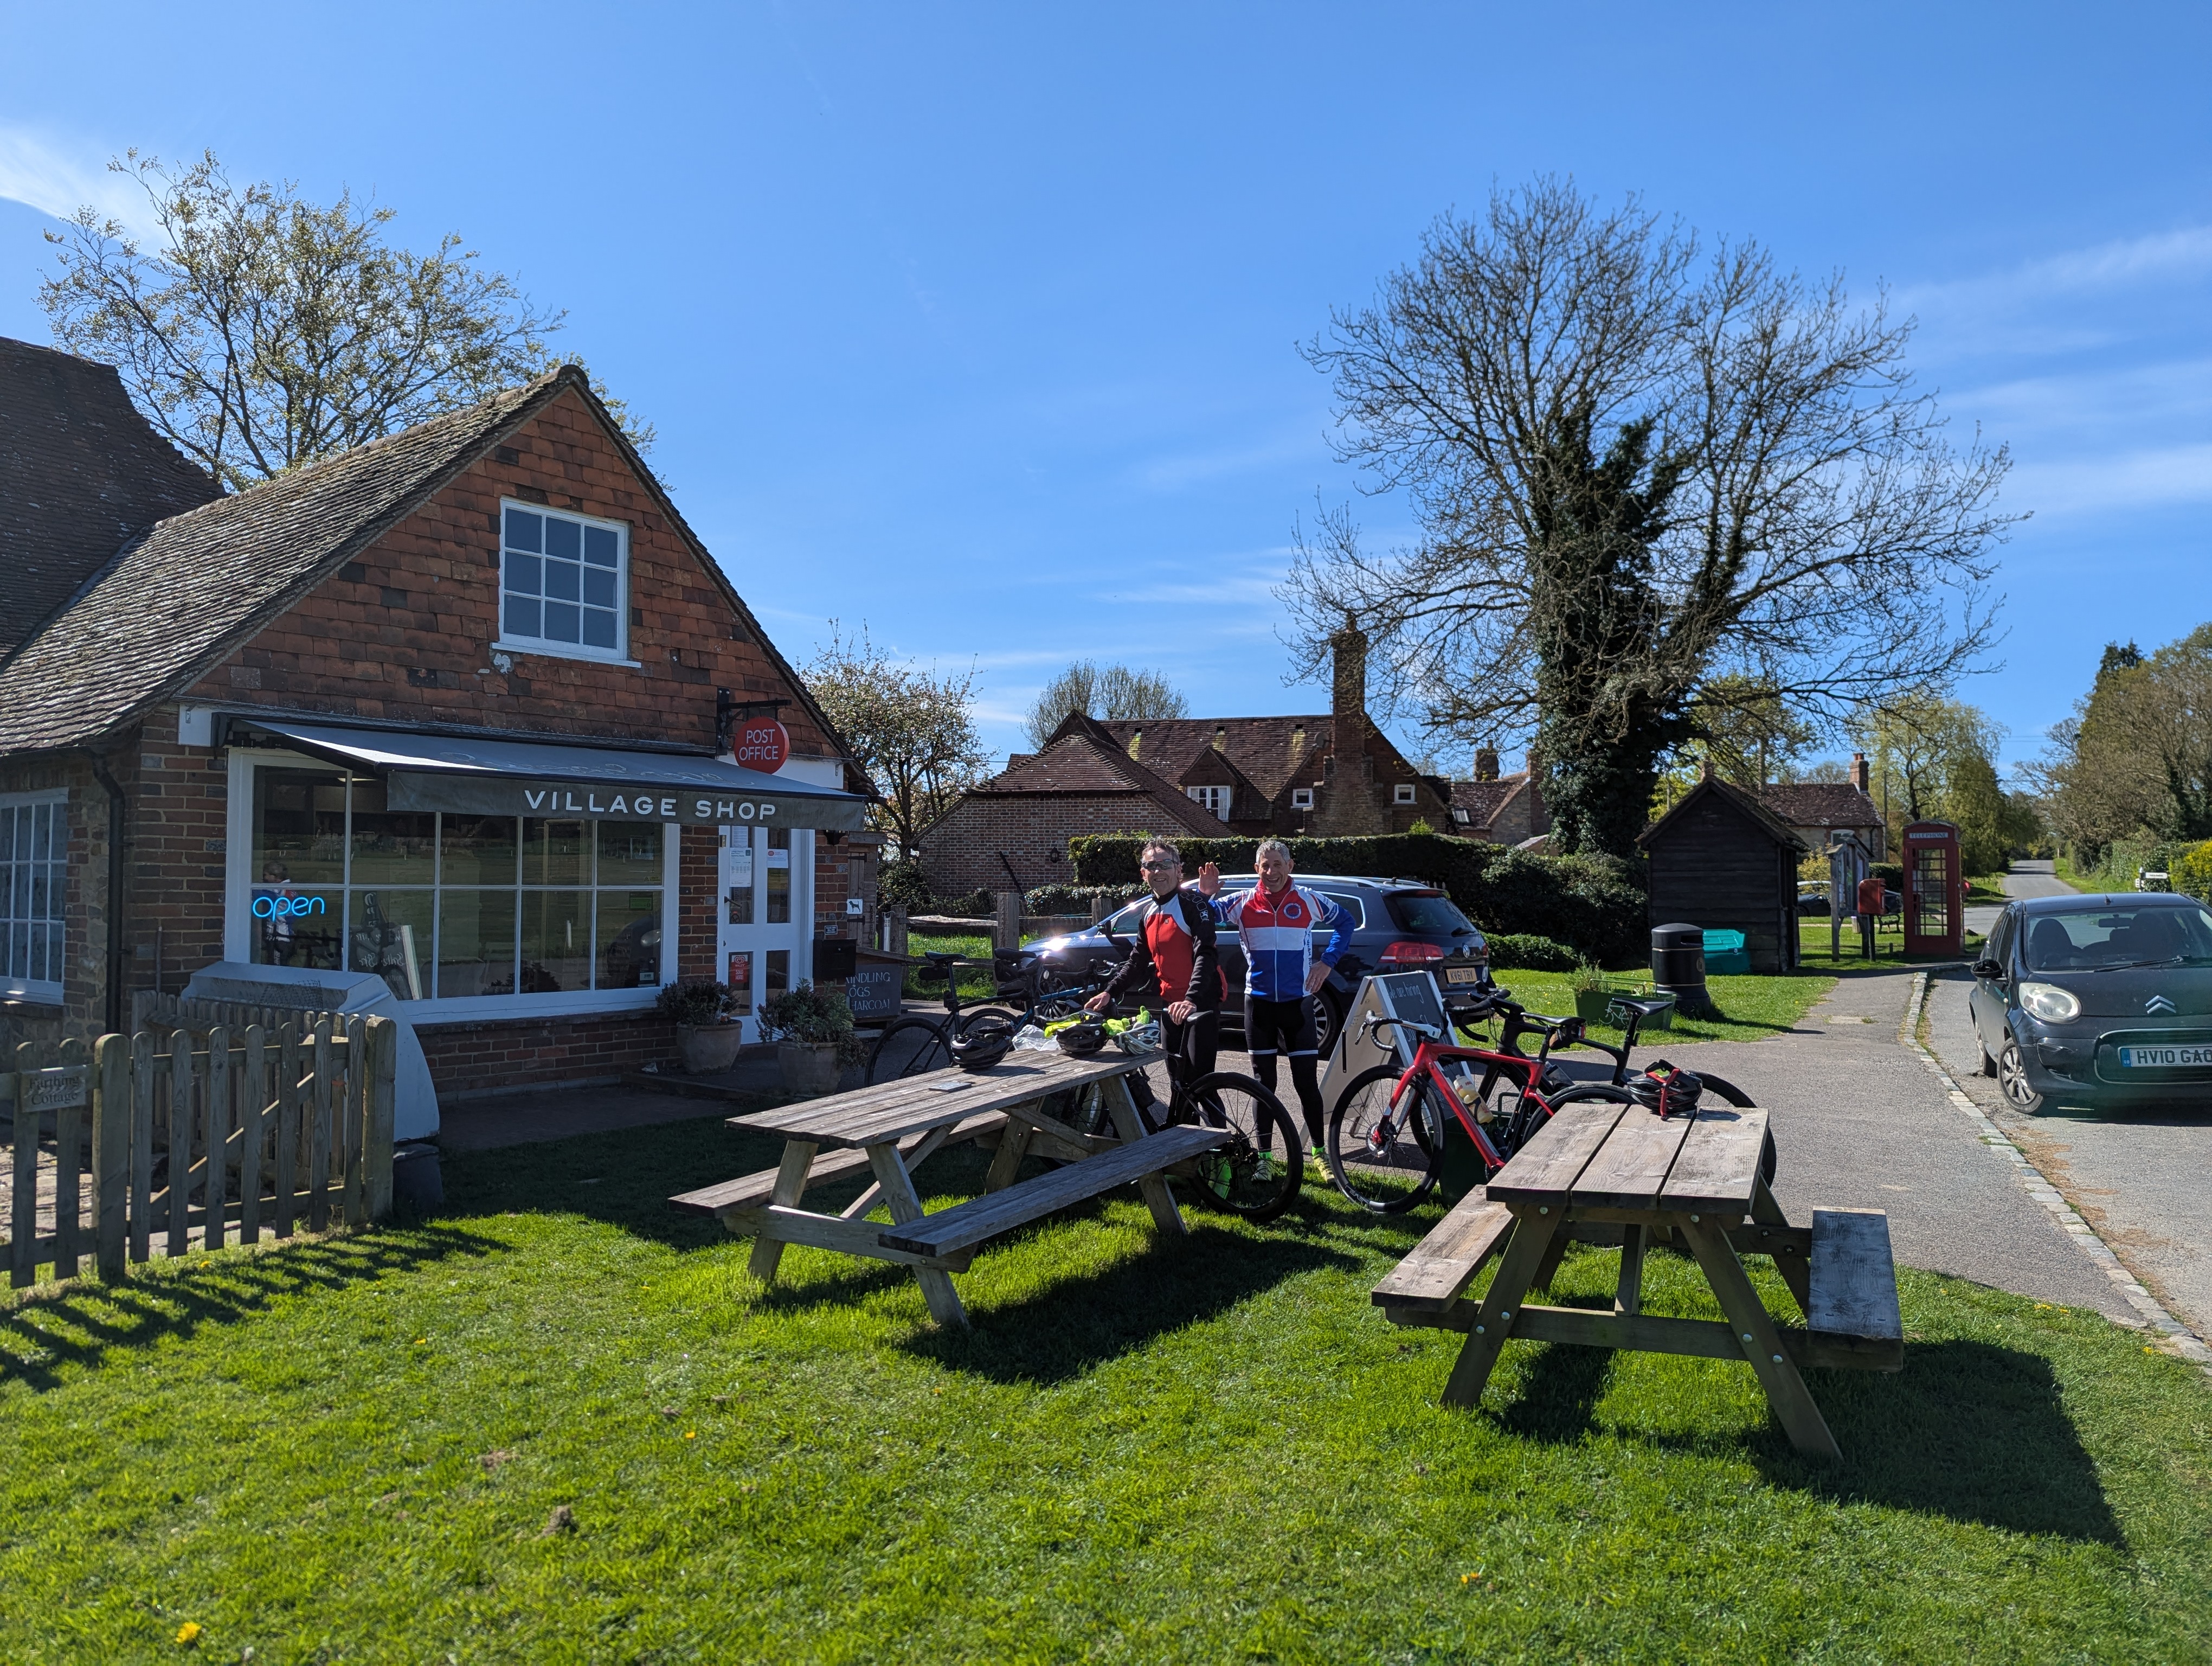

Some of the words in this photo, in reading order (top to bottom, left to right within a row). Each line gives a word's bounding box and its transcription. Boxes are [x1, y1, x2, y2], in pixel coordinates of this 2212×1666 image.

[746, 728, 775, 744] POST
[738, 745, 779, 761] OFFICE
[524, 790, 677, 816] VILLAGE
[695, 799, 776, 821] SHOP
[252, 896, 325, 922] open
[848, 986, 870, 997] OGS
[1396, 987, 1406, 997] are
[1402, 981, 1424, 1004] hiring
[2137, 1050, 2176, 1064] HV10
[31, 1092, 79, 1105] Cottage
